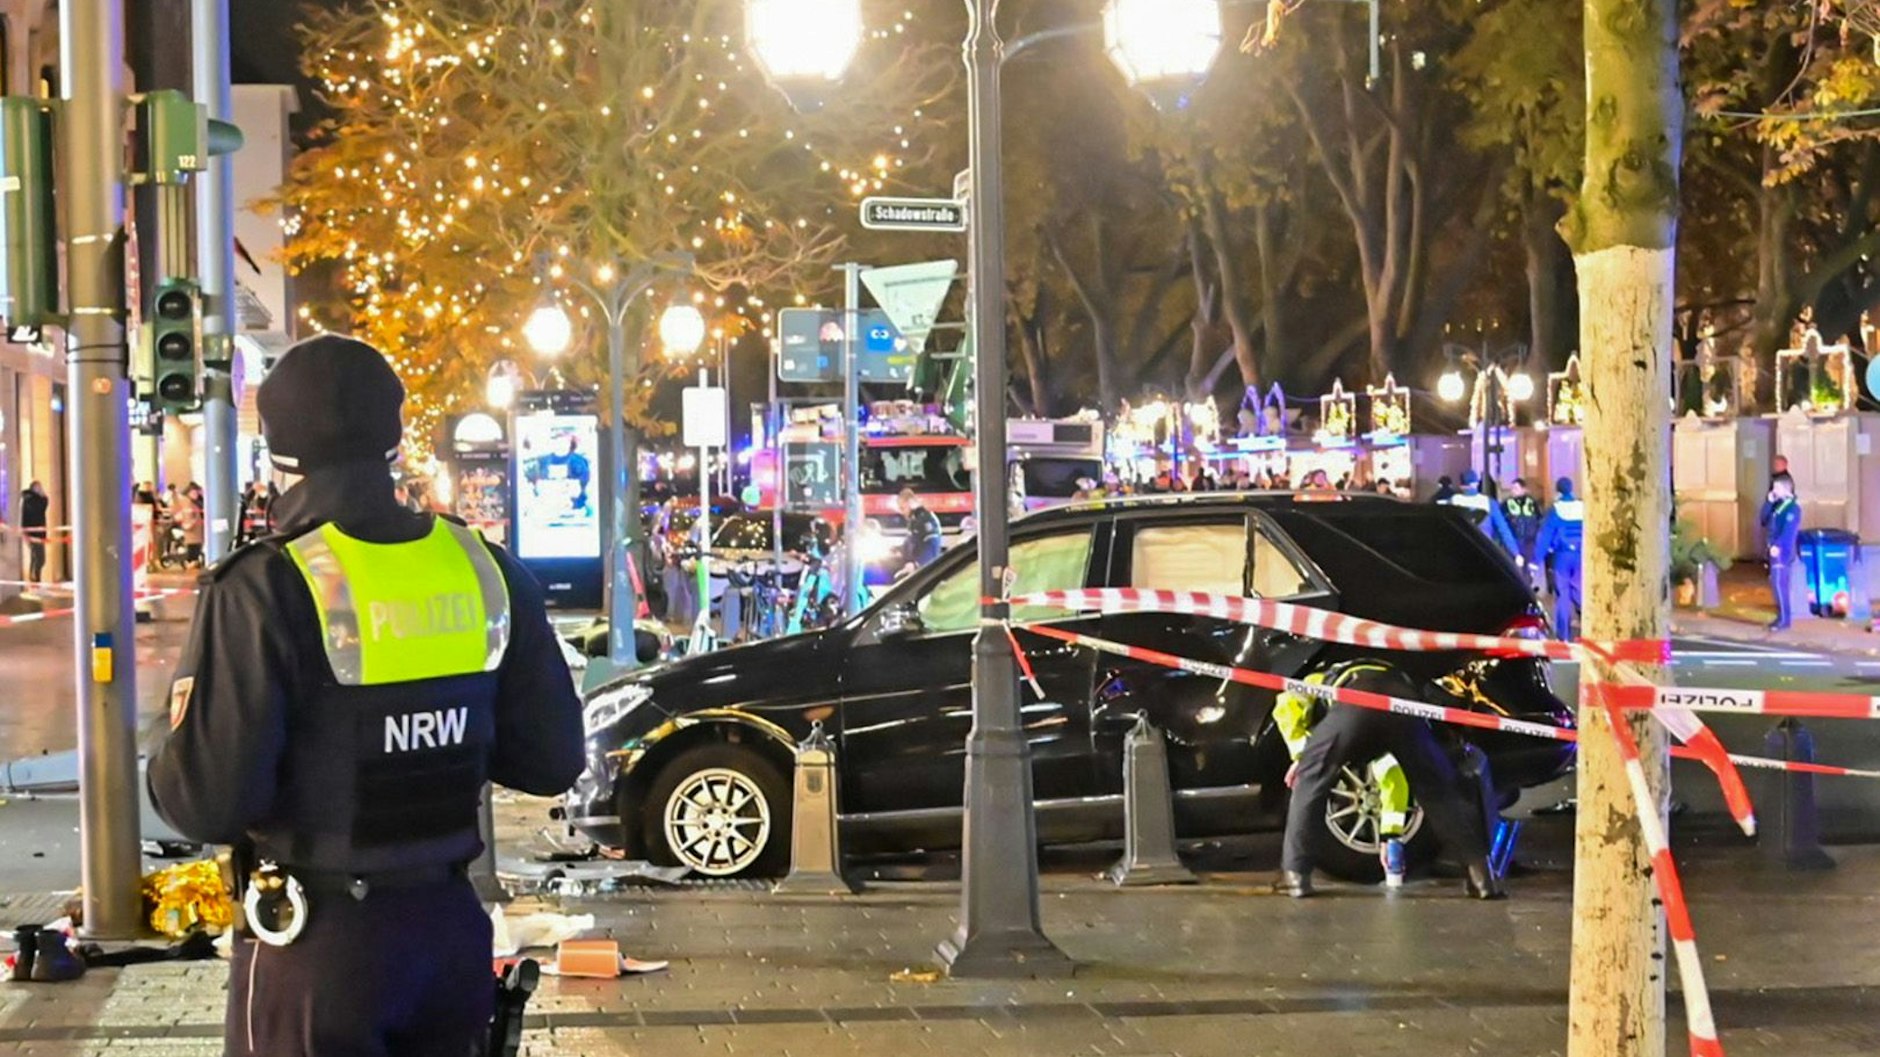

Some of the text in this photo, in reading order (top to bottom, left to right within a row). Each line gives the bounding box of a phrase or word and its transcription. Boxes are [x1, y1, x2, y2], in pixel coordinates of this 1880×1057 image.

[178, 154, 197, 169] 122
[875, 206, 955, 222] Schadowstraße
[369, 591, 478, 642] POLIZEI
[384, 706, 468, 754] NRW
